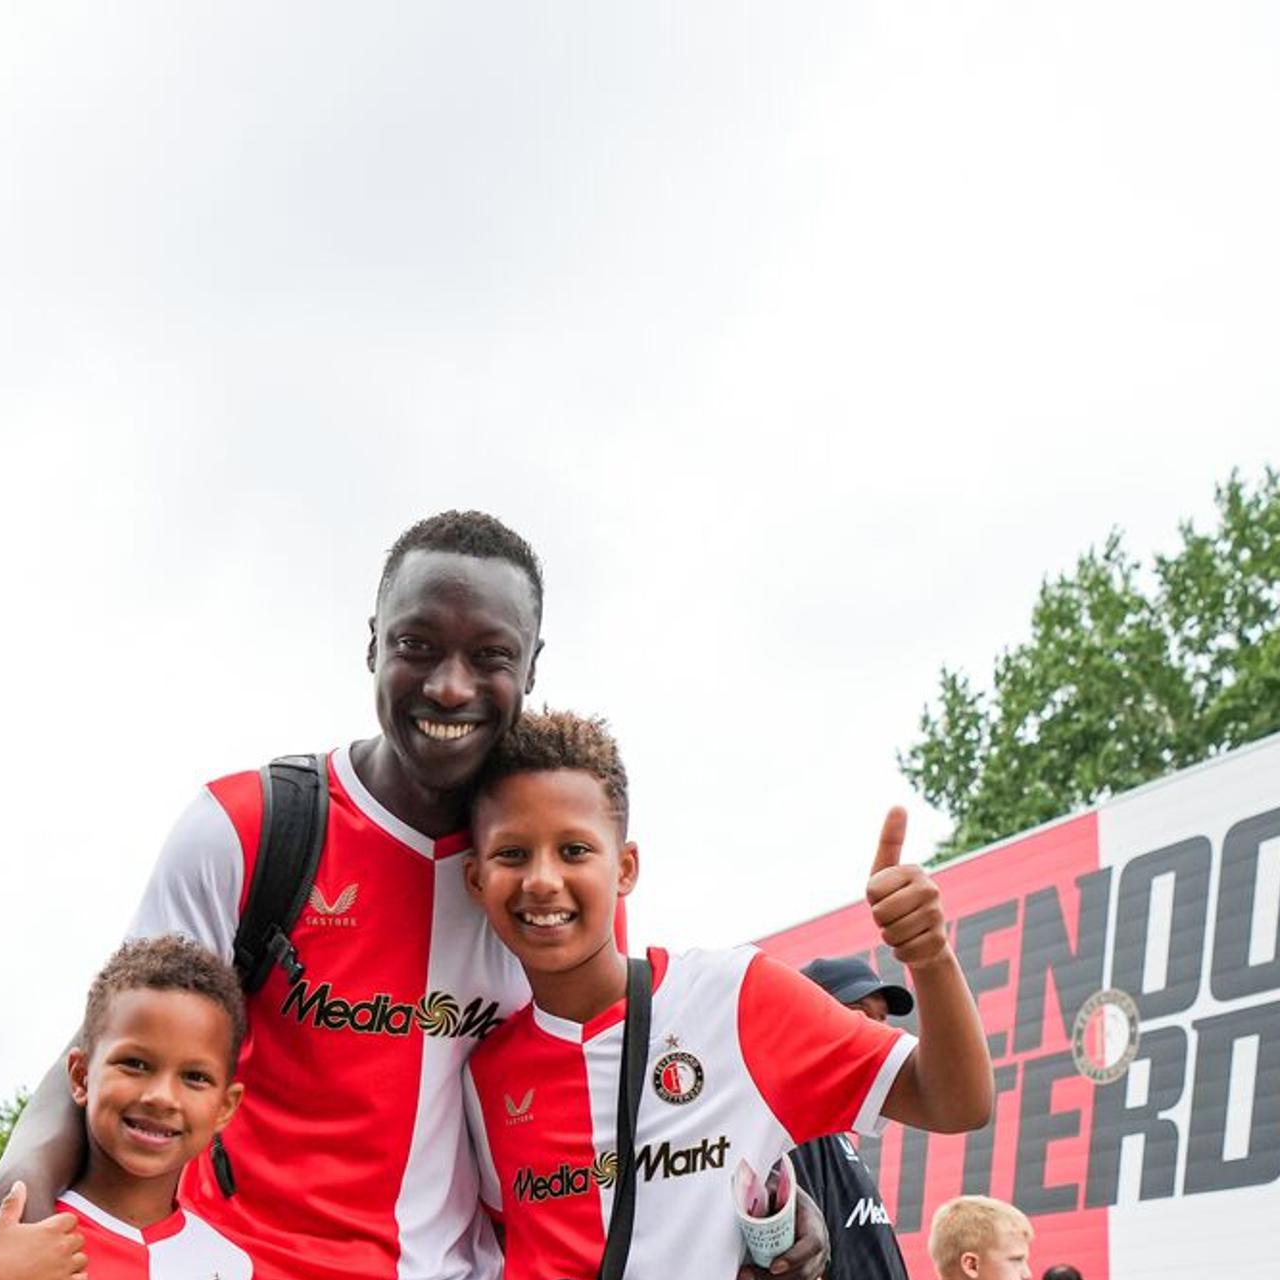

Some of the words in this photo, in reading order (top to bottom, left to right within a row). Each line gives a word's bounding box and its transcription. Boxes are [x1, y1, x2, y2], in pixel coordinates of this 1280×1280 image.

[281, 979, 414, 1036] Media
[513, 1164, 591, 1202] Media
[634, 1135, 731, 1183] Markt
